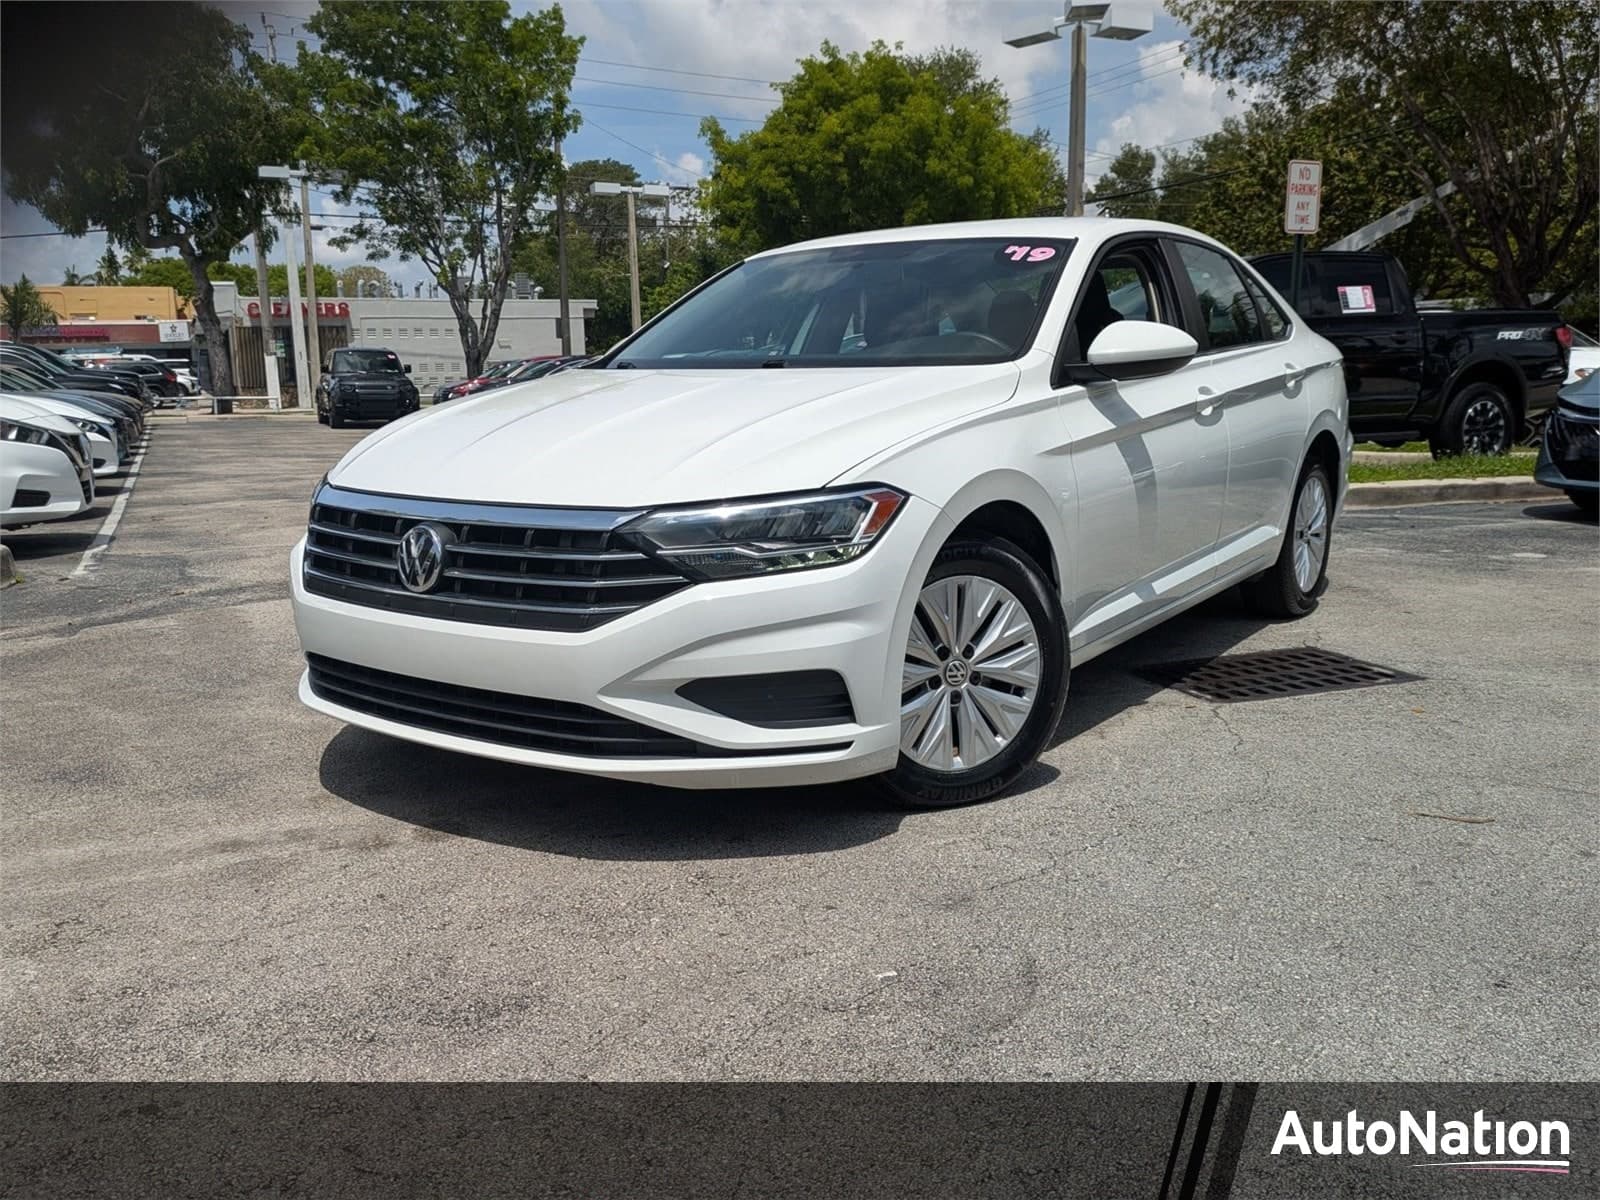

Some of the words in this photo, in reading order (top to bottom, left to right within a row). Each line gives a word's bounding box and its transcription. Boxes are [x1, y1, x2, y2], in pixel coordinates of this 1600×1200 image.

[1299, 167, 1311, 181] NO
[1290, 183, 1318, 196] PARKING
[1296, 201, 1310, 211] ANY
[1294, 214, 1310, 224] TIME
[247, 302, 351, 318] CENERS
